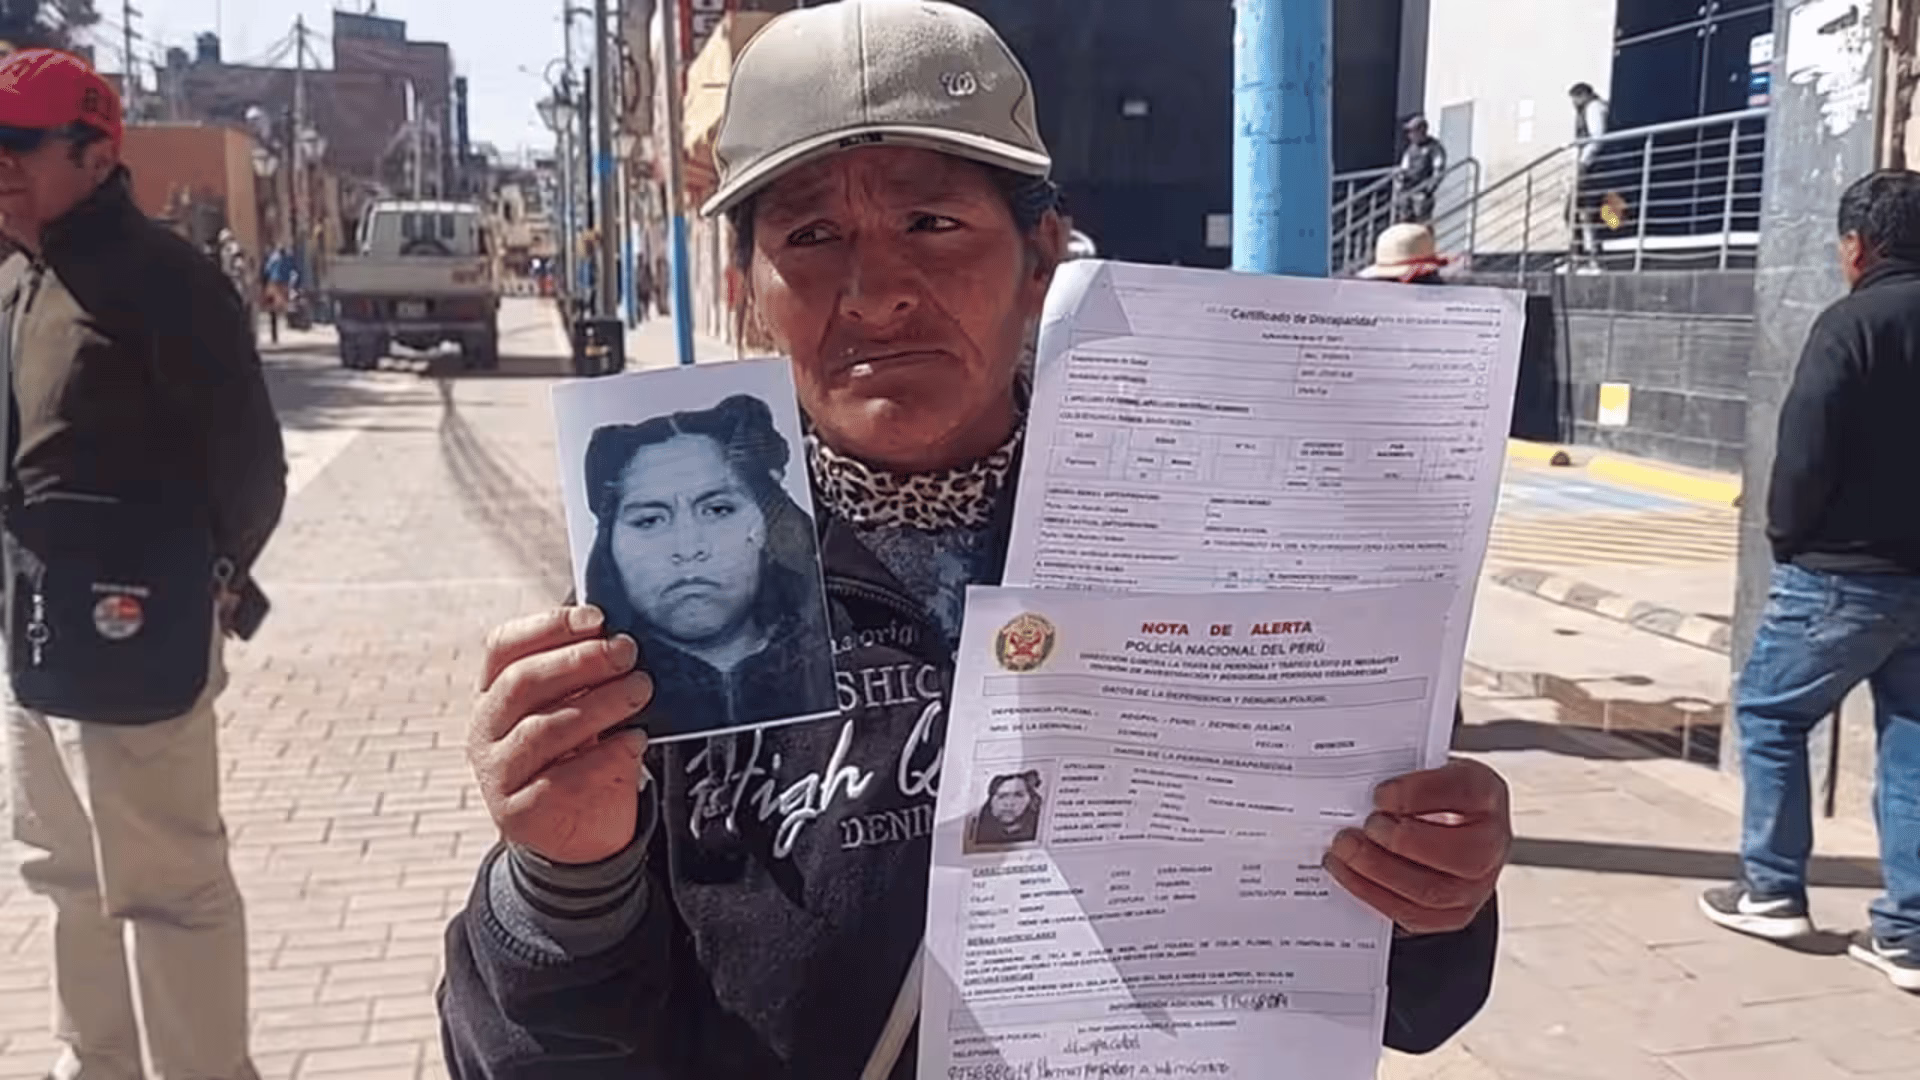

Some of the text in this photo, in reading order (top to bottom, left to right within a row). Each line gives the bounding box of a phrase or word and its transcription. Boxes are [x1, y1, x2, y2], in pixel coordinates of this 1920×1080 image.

[1231, 308, 1290, 323] Certificado
[1294, 313, 1307, 324] de
[1141, 621, 1312, 636] NOTA DE ALERTA
[1125, 639, 1326, 656] POLICÍA NACIONAL DEL PERÚ
[1102, 685, 1133, 695] DATOS
[1136, 688, 1149, 696] DE
[1152, 689, 1163, 697] LA
[1026, 722, 1037, 730] LA
[1162, 751, 1174, 759] LA
